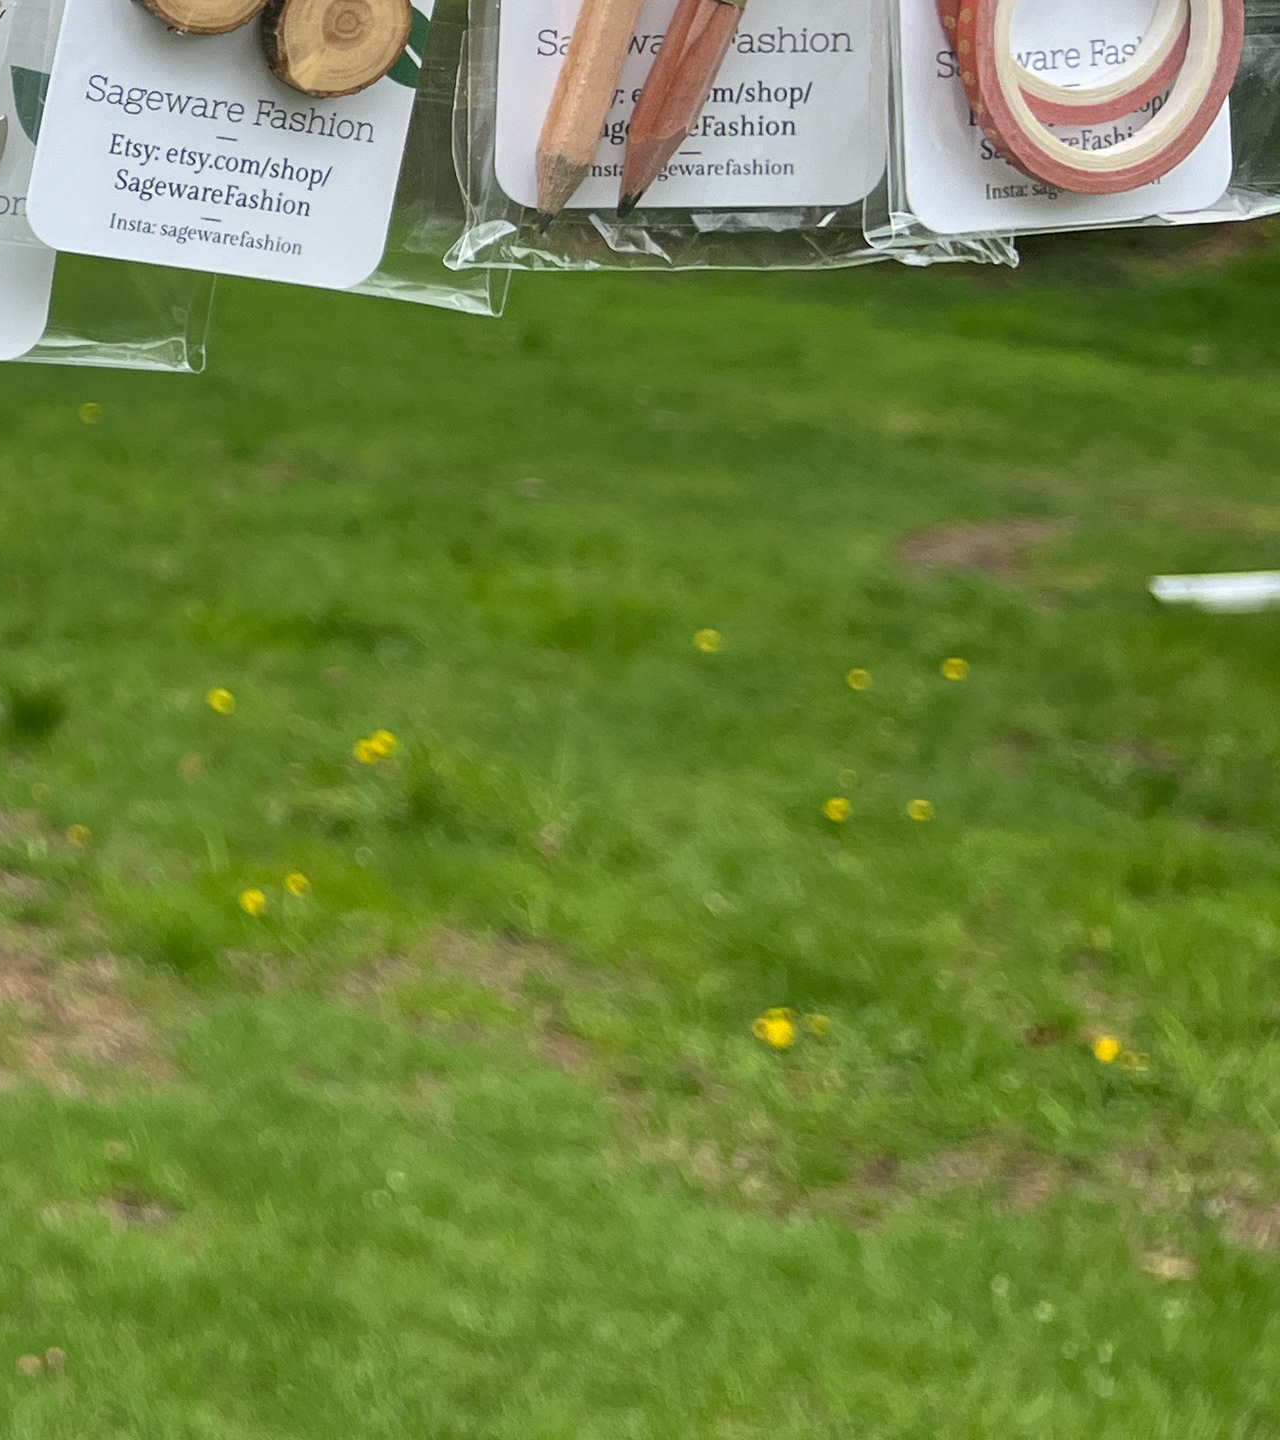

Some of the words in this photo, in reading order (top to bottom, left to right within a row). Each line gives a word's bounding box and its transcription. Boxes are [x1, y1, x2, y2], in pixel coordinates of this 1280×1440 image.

[732, 26, 853, 54] ashion
[86, 74, 245, 123] Sageware
[253, 100, 375, 143] Fashion
[108, 133, 160, 166] Etsy:
[166, 146, 333, 191] etsy.com/shop/
[657, 158, 794, 182] gewarefashion
[115, 168, 312, 217] SagewareFashion
[109, 213, 156, 236] Insta:
[160, 222, 303, 255] sagewarefashion
